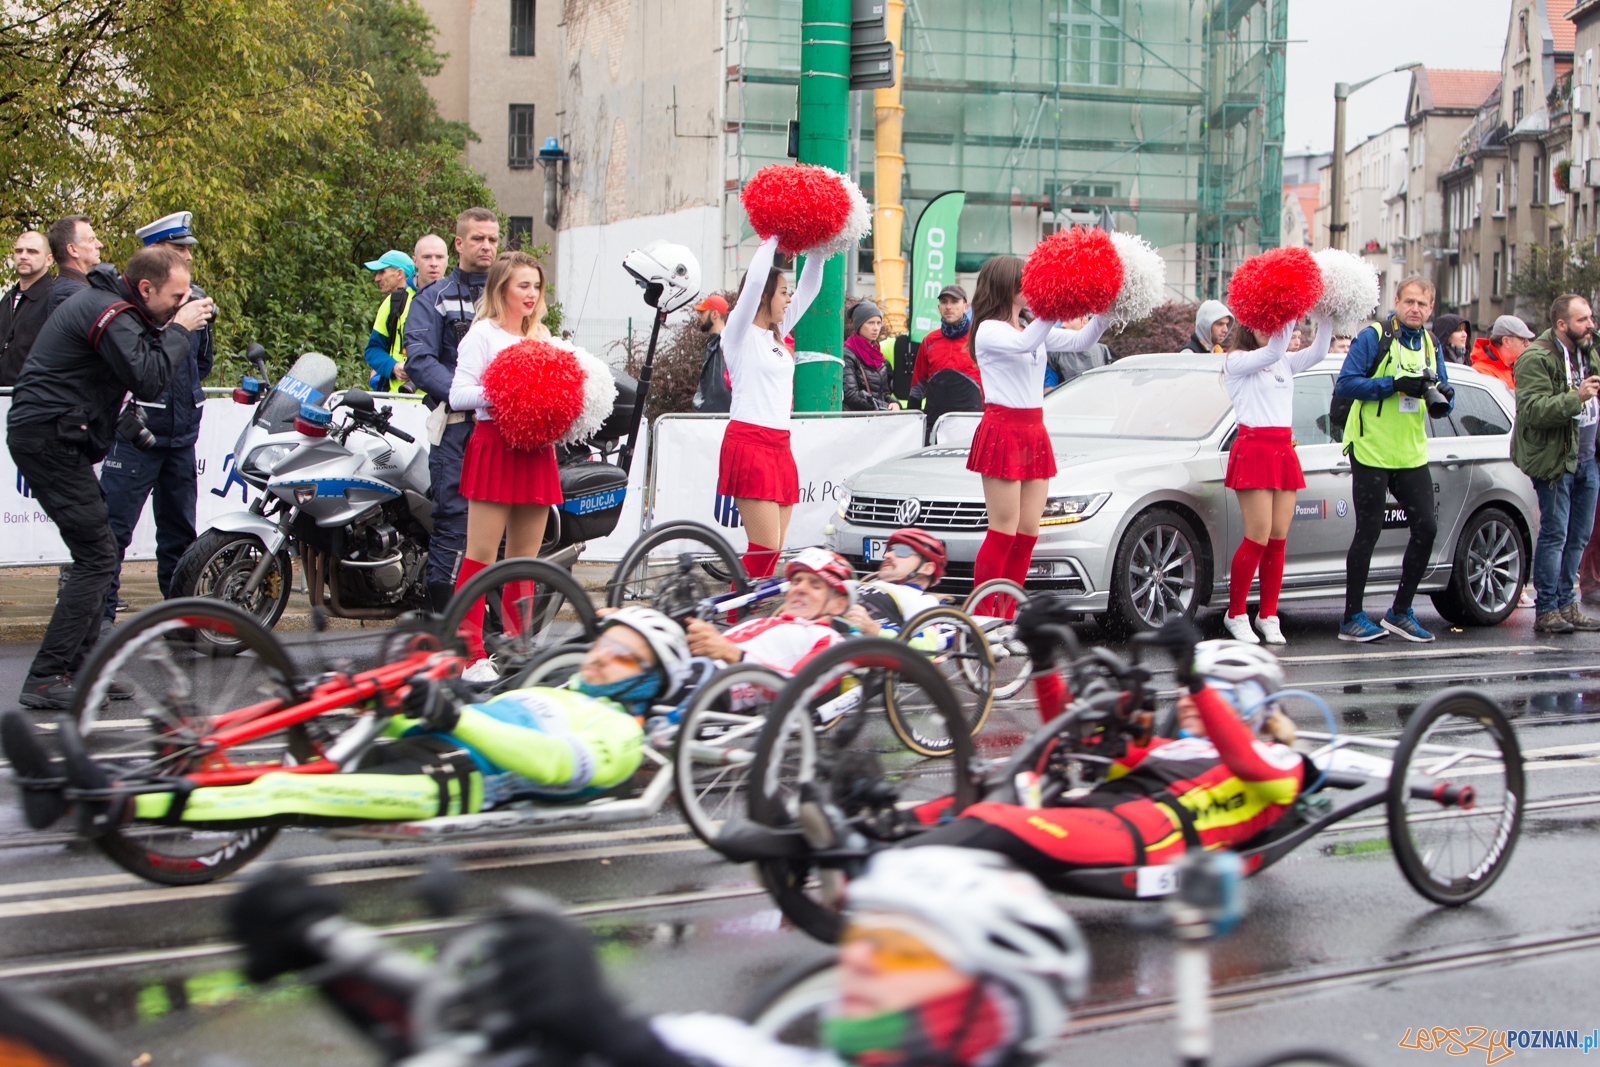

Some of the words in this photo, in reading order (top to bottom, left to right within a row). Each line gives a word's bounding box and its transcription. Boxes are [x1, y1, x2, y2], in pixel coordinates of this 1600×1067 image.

[924, 227, 945, 299] 3:00
[278, 375, 312, 403] OLICJA
[105, 460, 122, 469] POLICJA
[798, 481, 816, 503] nk
[580, 493, 615, 511] POLICJA
[1295, 504, 1319, 515] Poznań
[3, 511, 30, 524] Bank
